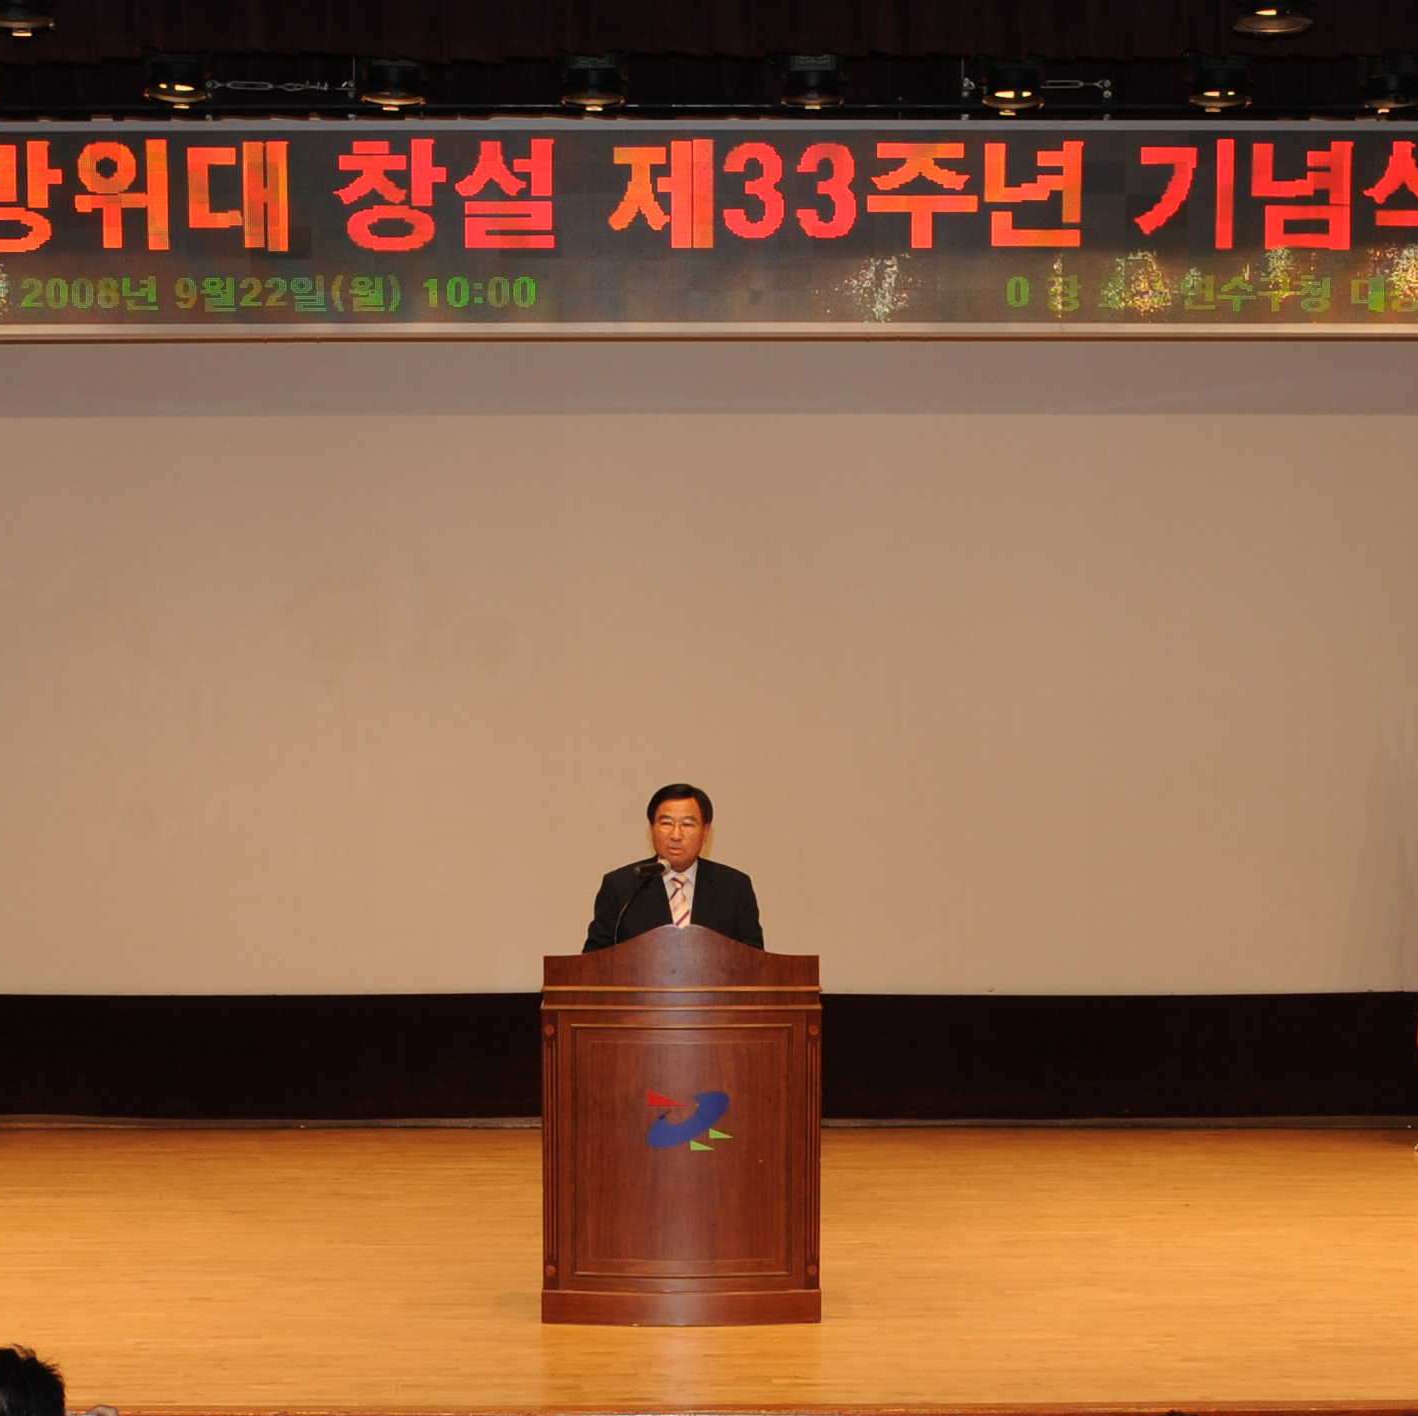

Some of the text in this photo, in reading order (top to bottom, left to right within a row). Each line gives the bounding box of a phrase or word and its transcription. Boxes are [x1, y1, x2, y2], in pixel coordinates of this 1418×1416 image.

[334, 139, 555, 253] 창설
[608, 139, 1085, 250] 제33주년
[21, 275, 159, 311] 2008년
[423, 276, 536, 308] 10:00
